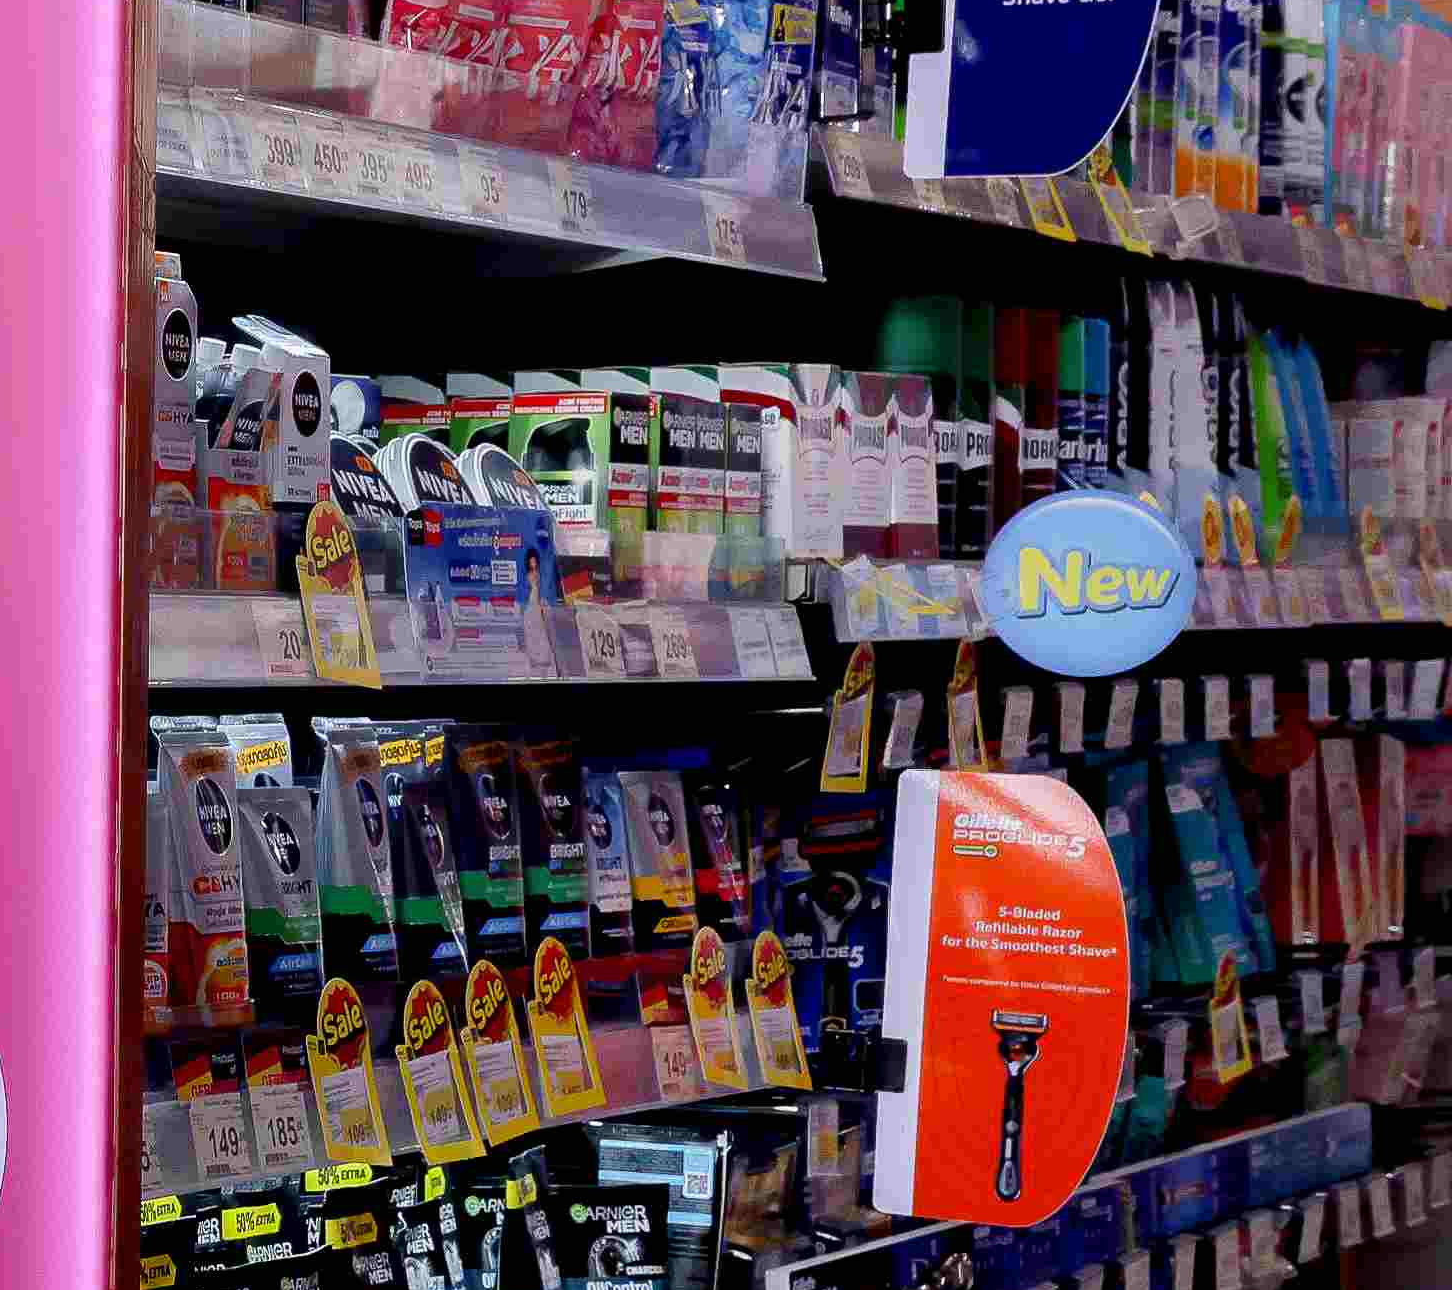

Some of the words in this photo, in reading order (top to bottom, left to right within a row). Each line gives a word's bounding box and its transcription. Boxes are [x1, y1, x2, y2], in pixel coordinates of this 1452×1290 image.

[1018, 545, 1178, 617] New
[999, 905, 1061, 921] 5-Bladed
[1042, 925, 1083, 939] Razor
[942, 935, 962, 949] for
[966, 936, 988, 948] the
[991, 939, 1065, 955] Smoothest
